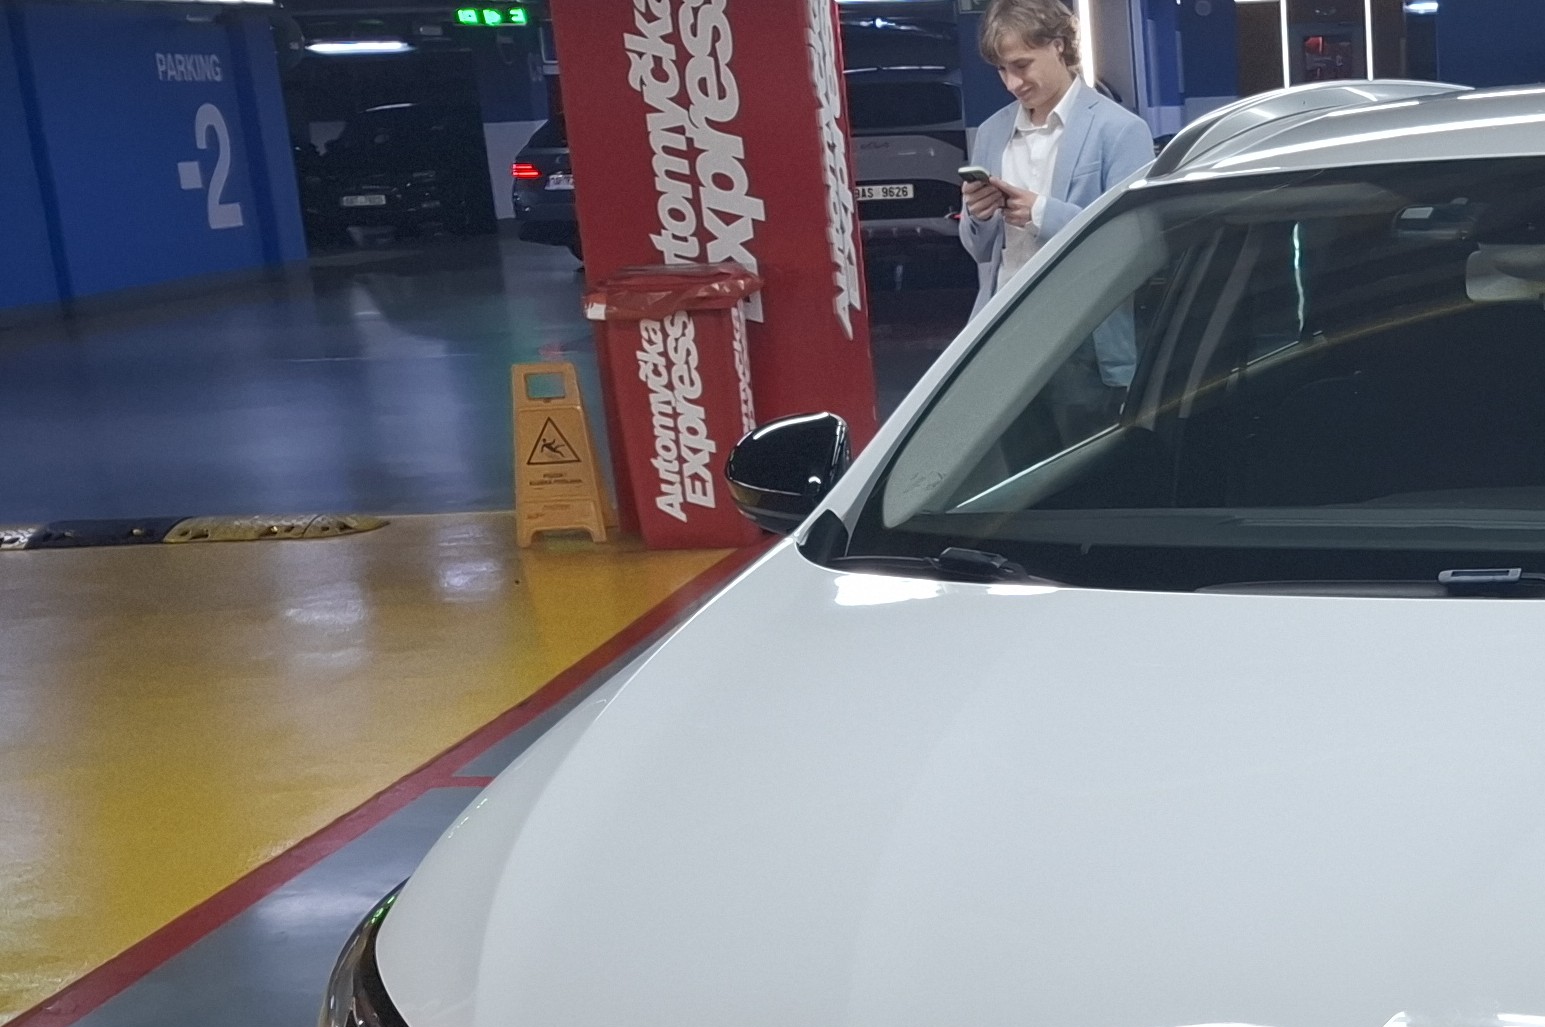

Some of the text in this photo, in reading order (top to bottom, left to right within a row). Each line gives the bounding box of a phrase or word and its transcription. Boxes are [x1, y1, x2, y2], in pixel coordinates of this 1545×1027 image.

[155, 52, 223, 82] PARKING
[177, 102, 244, 230] -2
[881, 186, 909, 198] 9626
[635, 317, 688, 523] Automyčka
[663, 310, 717, 509] Express
